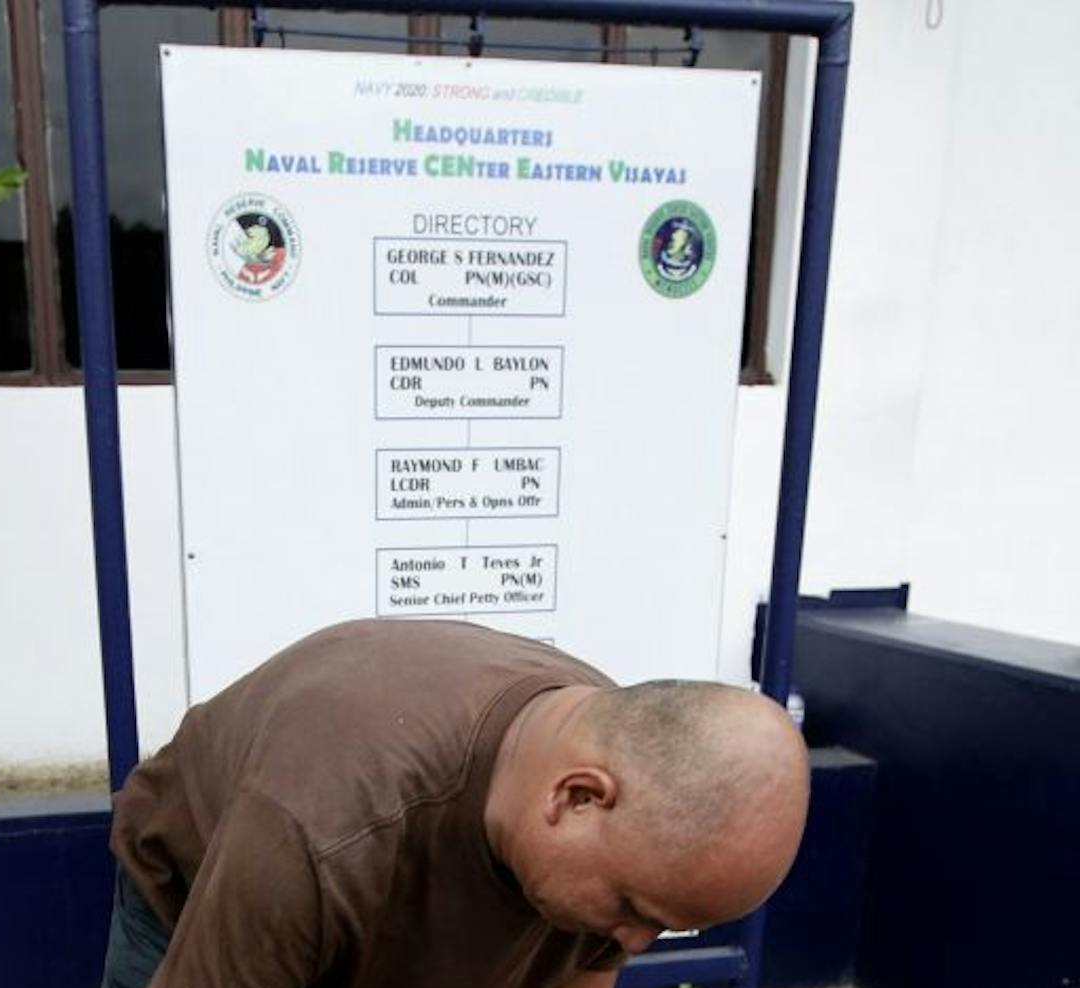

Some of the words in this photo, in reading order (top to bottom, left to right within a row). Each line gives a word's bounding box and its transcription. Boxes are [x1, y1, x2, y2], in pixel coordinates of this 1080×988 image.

[354, 81, 392, 96] NAVY
[432, 85, 490, 100] STRONG
[414, 214, 537, 236] DIRECTORY
[387, 249, 447, 264] GEORGE
[455, 251, 463, 265] S
[469, 251, 555, 266] FERNANDEZ
[389, 270, 420, 285] COL
[465, 271, 552, 288] PN(M)(GSC)
[429, 295, 507, 308] Commander
[390, 357, 464, 371] EDMUNDO
[475, 357, 484, 371] L
[494, 357, 549, 371] BAYLON
[390, 376, 422, 390] CDR
[530, 377, 549, 390] PN
[414, 396, 454, 409] Deputy
[460, 396, 530, 407] Commander
[391, 459, 462, 473] RAYMOND
[471, 459, 479, 472] F
[391, 478, 430, 491] LCDR
[521, 476, 540, 489] PN
[470, 498, 477, 507] &
[391, 558, 445, 571] Antonio
[461, 557, 468, 569] T
[483, 557, 520, 569] Teves
[529, 556, 543, 568] Jr
[391, 576, 420, 589] SMS
[501, 573, 542, 587] PN(M)
[390, 594, 430, 607] Senior
[434, 593, 465, 605] Chief
[470, 593, 499, 605] Petty
[504, 592, 543, 603] Officer
